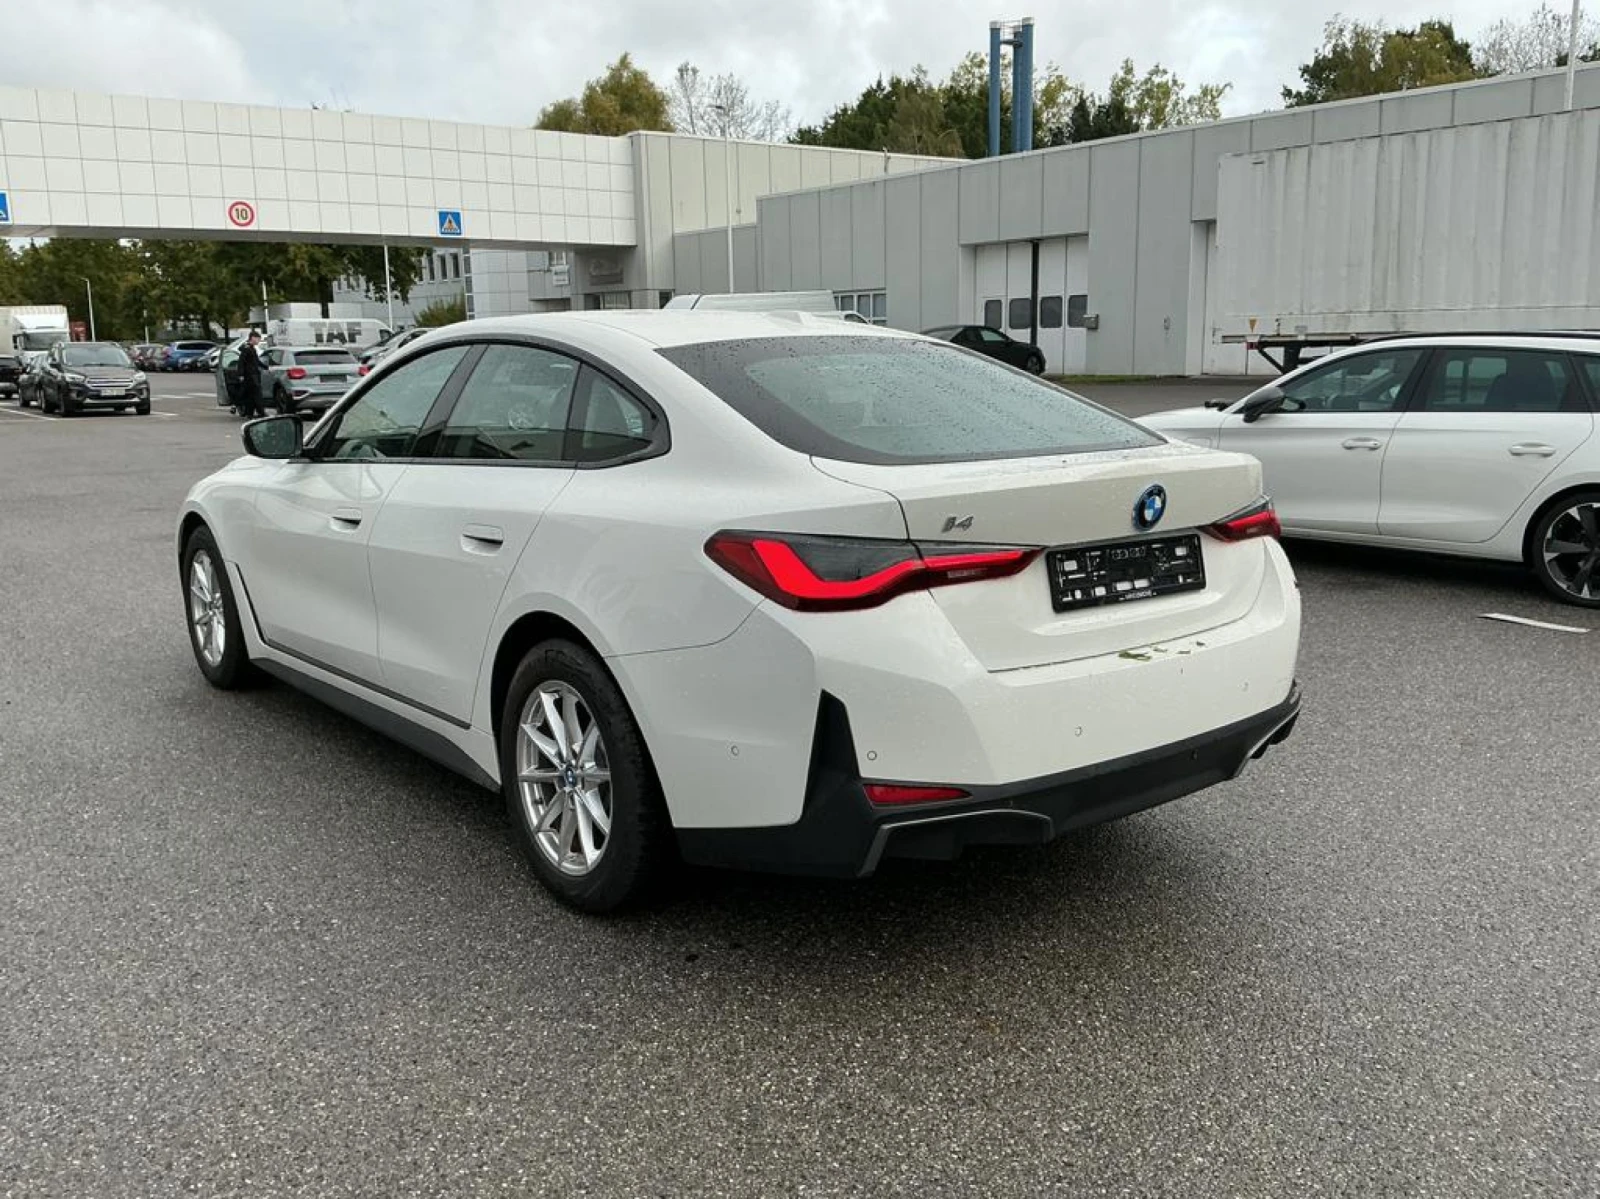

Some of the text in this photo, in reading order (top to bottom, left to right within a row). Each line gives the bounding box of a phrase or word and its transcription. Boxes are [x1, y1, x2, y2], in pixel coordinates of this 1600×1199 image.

[235, 208, 248, 220] 10
[310, 321, 362, 343] TAF
[941, 515, 974, 533] i4
